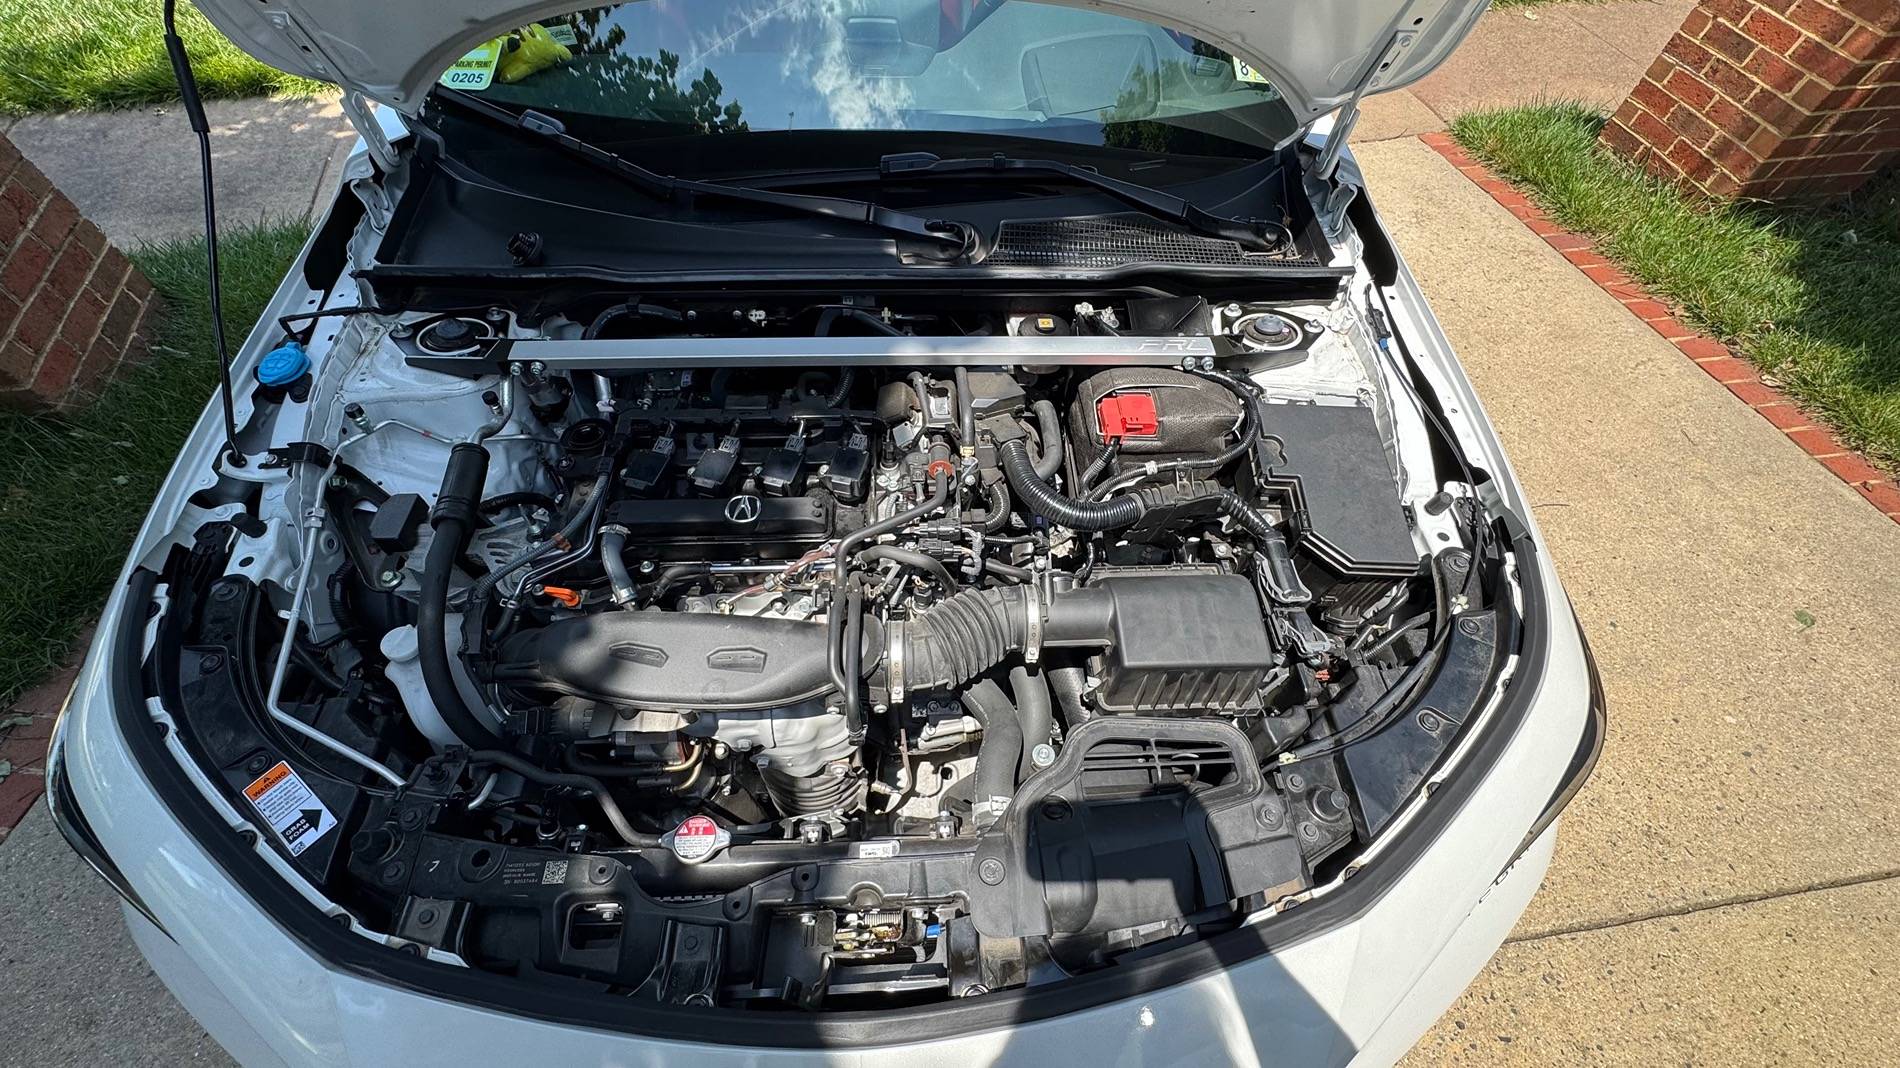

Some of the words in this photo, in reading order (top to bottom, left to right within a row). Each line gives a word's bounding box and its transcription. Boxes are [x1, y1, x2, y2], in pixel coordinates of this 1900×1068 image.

[451, 72, 485, 84] 0205
[252, 771, 287, 798] WARNING
[285, 818, 306, 836] GRAB
[288, 822, 311, 841] FOAM
